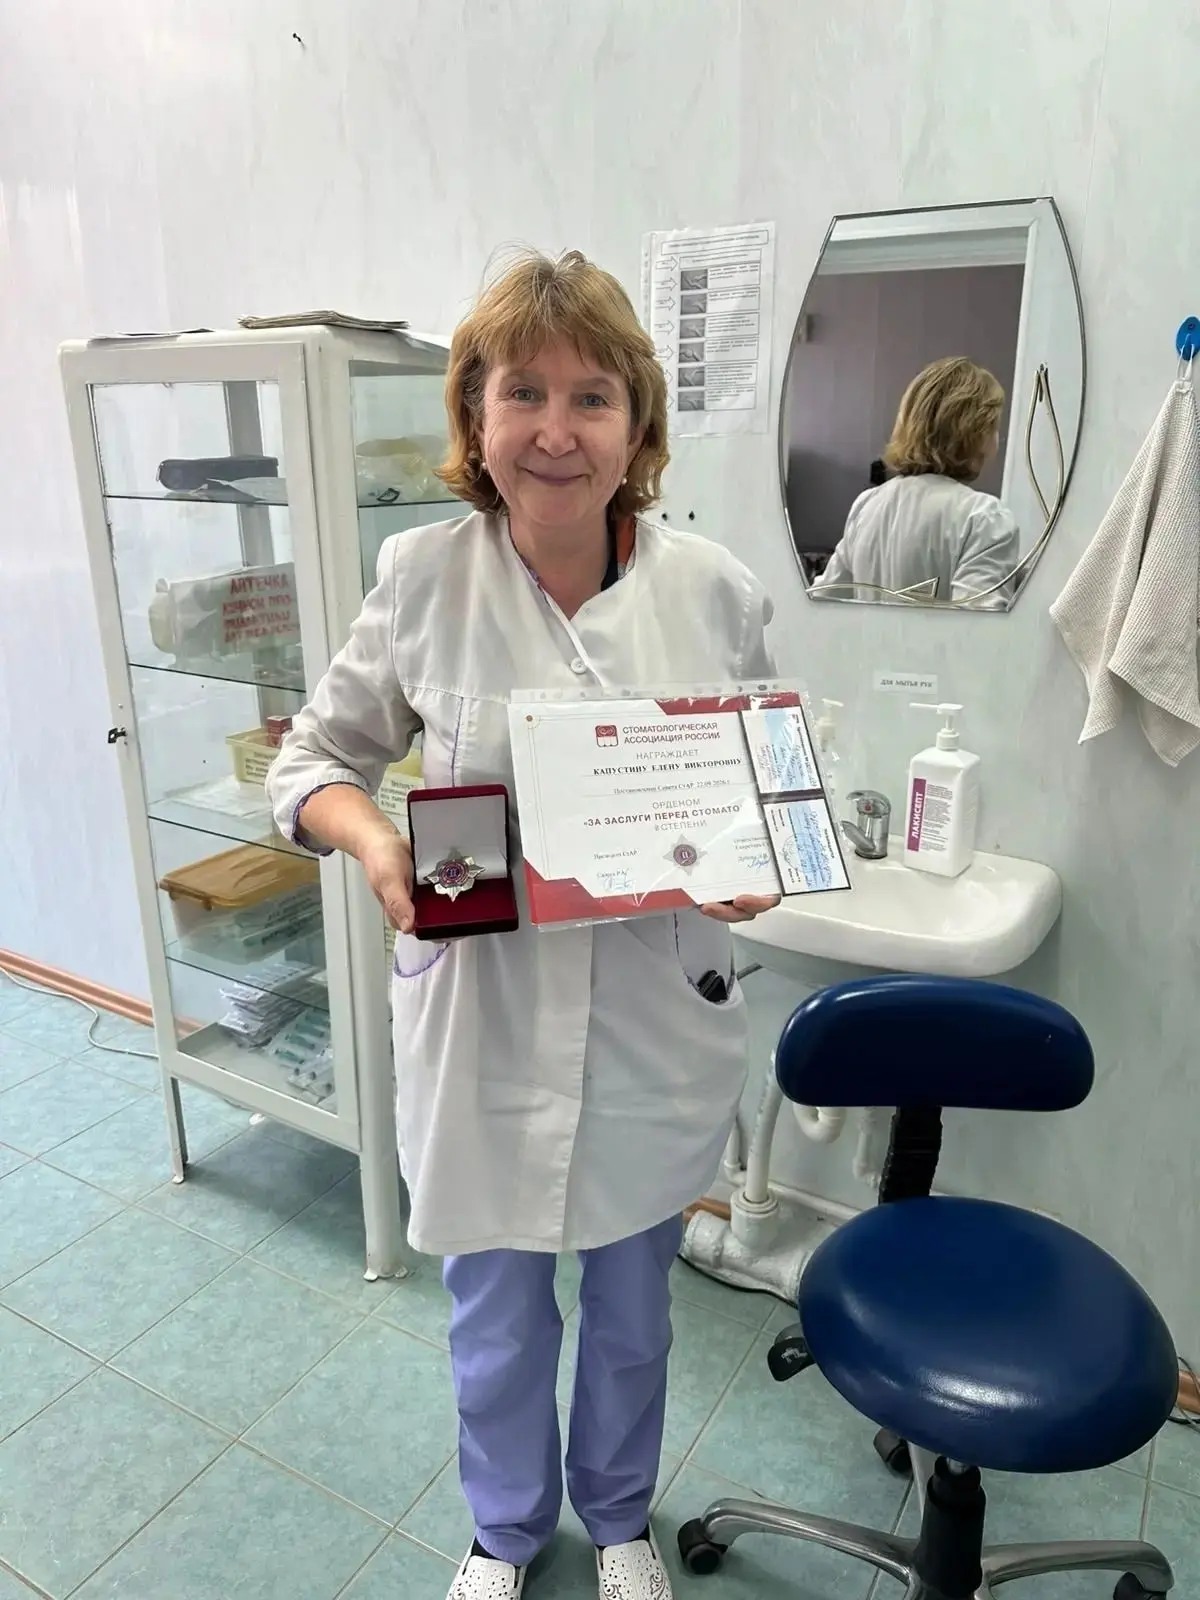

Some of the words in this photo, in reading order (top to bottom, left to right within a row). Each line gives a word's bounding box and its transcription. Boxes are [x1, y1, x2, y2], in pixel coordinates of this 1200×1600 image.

[230, 573, 289, 595] АПТЕЧКА
[895, 679, 918, 687] МЫТЬЯ
[622, 722, 718, 734] СТОМАТОЛОГИЧЕСКАЯ
[623, 733, 683, 744] АССОЦИАЦИЯ
[684, 732, 721, 741] РОССИИ
[636, 749, 699, 760] НАГРАЖДАЕТ
[593, 765, 647, 776] КАПУСТИНУ
[652, 763, 680, 772] ЕЛЕНУ
[684, 758, 741, 769] ВИКТОРОВНУ
[652, 798, 700, 810] ОРДЕНОМ
[583, 818, 602, 827] «ЗА
[604, 814, 651, 825] ЗАСЛУГИ
[654, 810, 689, 821] ПЕРЕД
[691, 804, 743, 817] СТОМАТО
[911, 791, 924, 839] ЛАКИСЕПТ
[660, 819, 707, 832] СТЕПЕНИ
